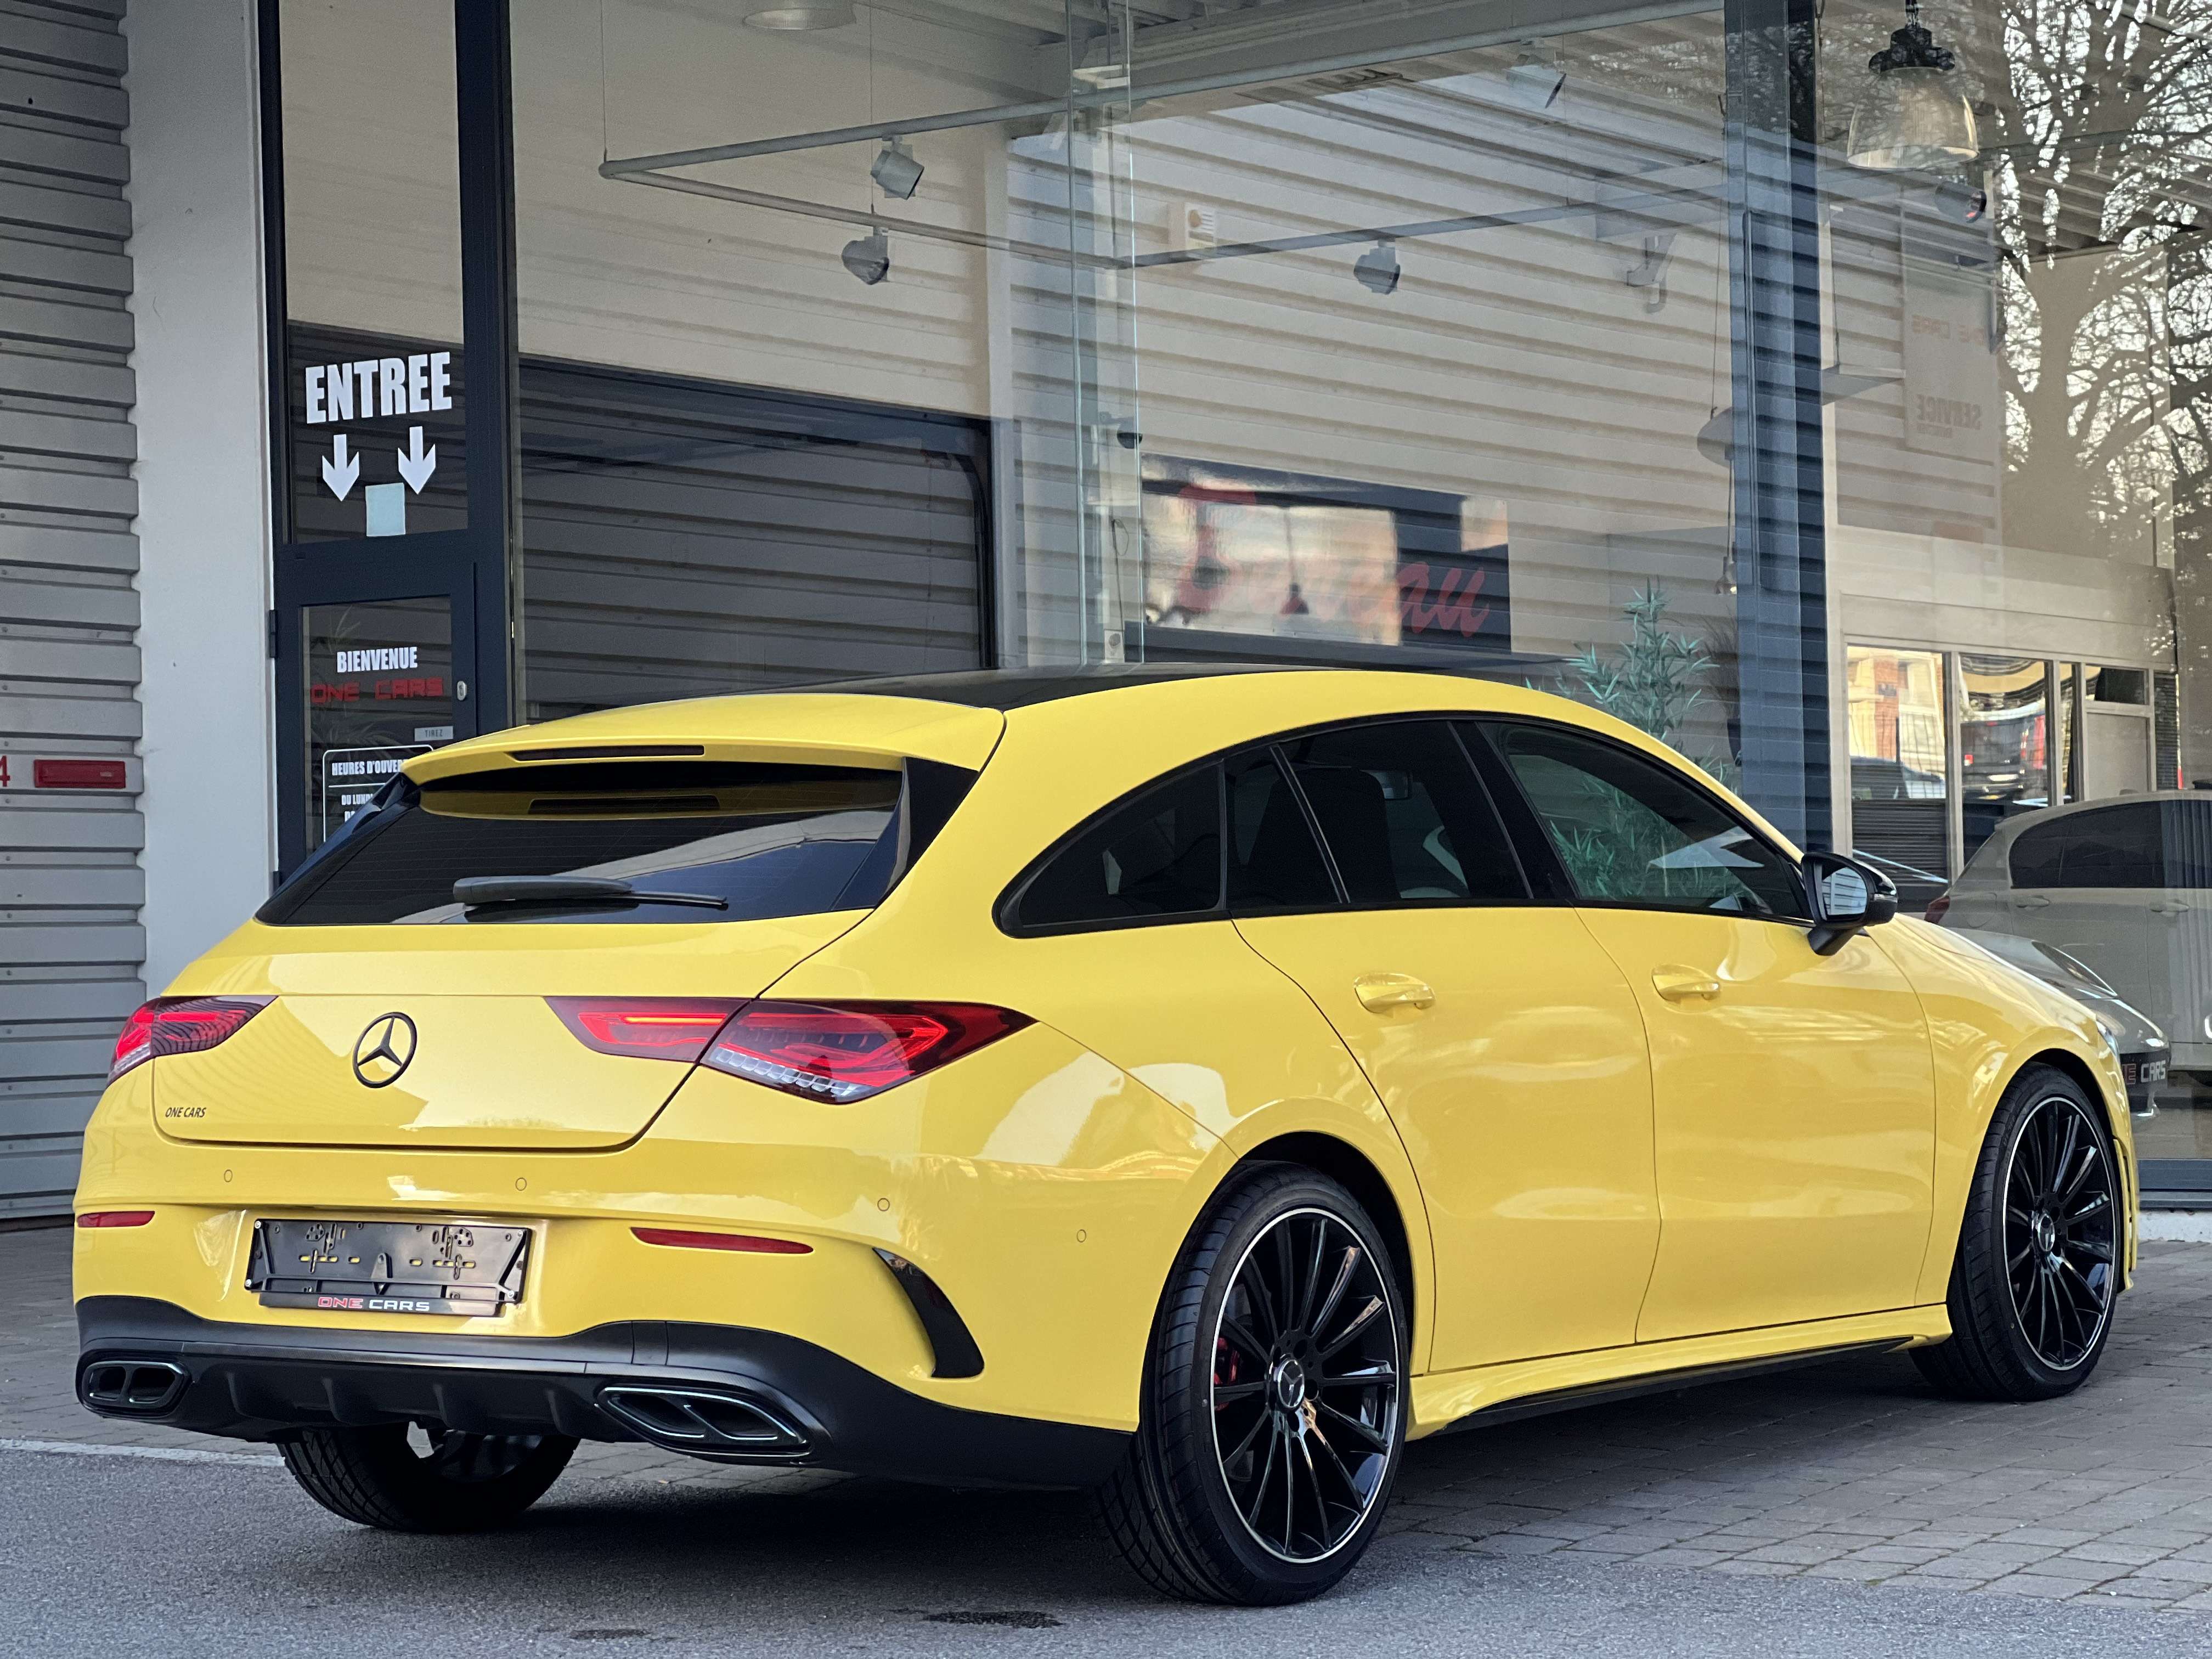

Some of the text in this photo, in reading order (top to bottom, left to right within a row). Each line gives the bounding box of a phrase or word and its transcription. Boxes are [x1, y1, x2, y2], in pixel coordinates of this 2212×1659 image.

[305, 351, 452, 425] ENTREE
[336, 646, 418, 673] BIENVENUE
[310, 677, 444, 703] ONE CARS
[425, 729, 443, 738] TIREZ
[331, 761, 365, 776] HEURES
[341, 794, 352, 805] DU
[2141, 1060, 2166, 1083] CARS
[165, 1107, 207, 1118] ONE CARS
[318, 1296, 430, 1312] ONE CARS
